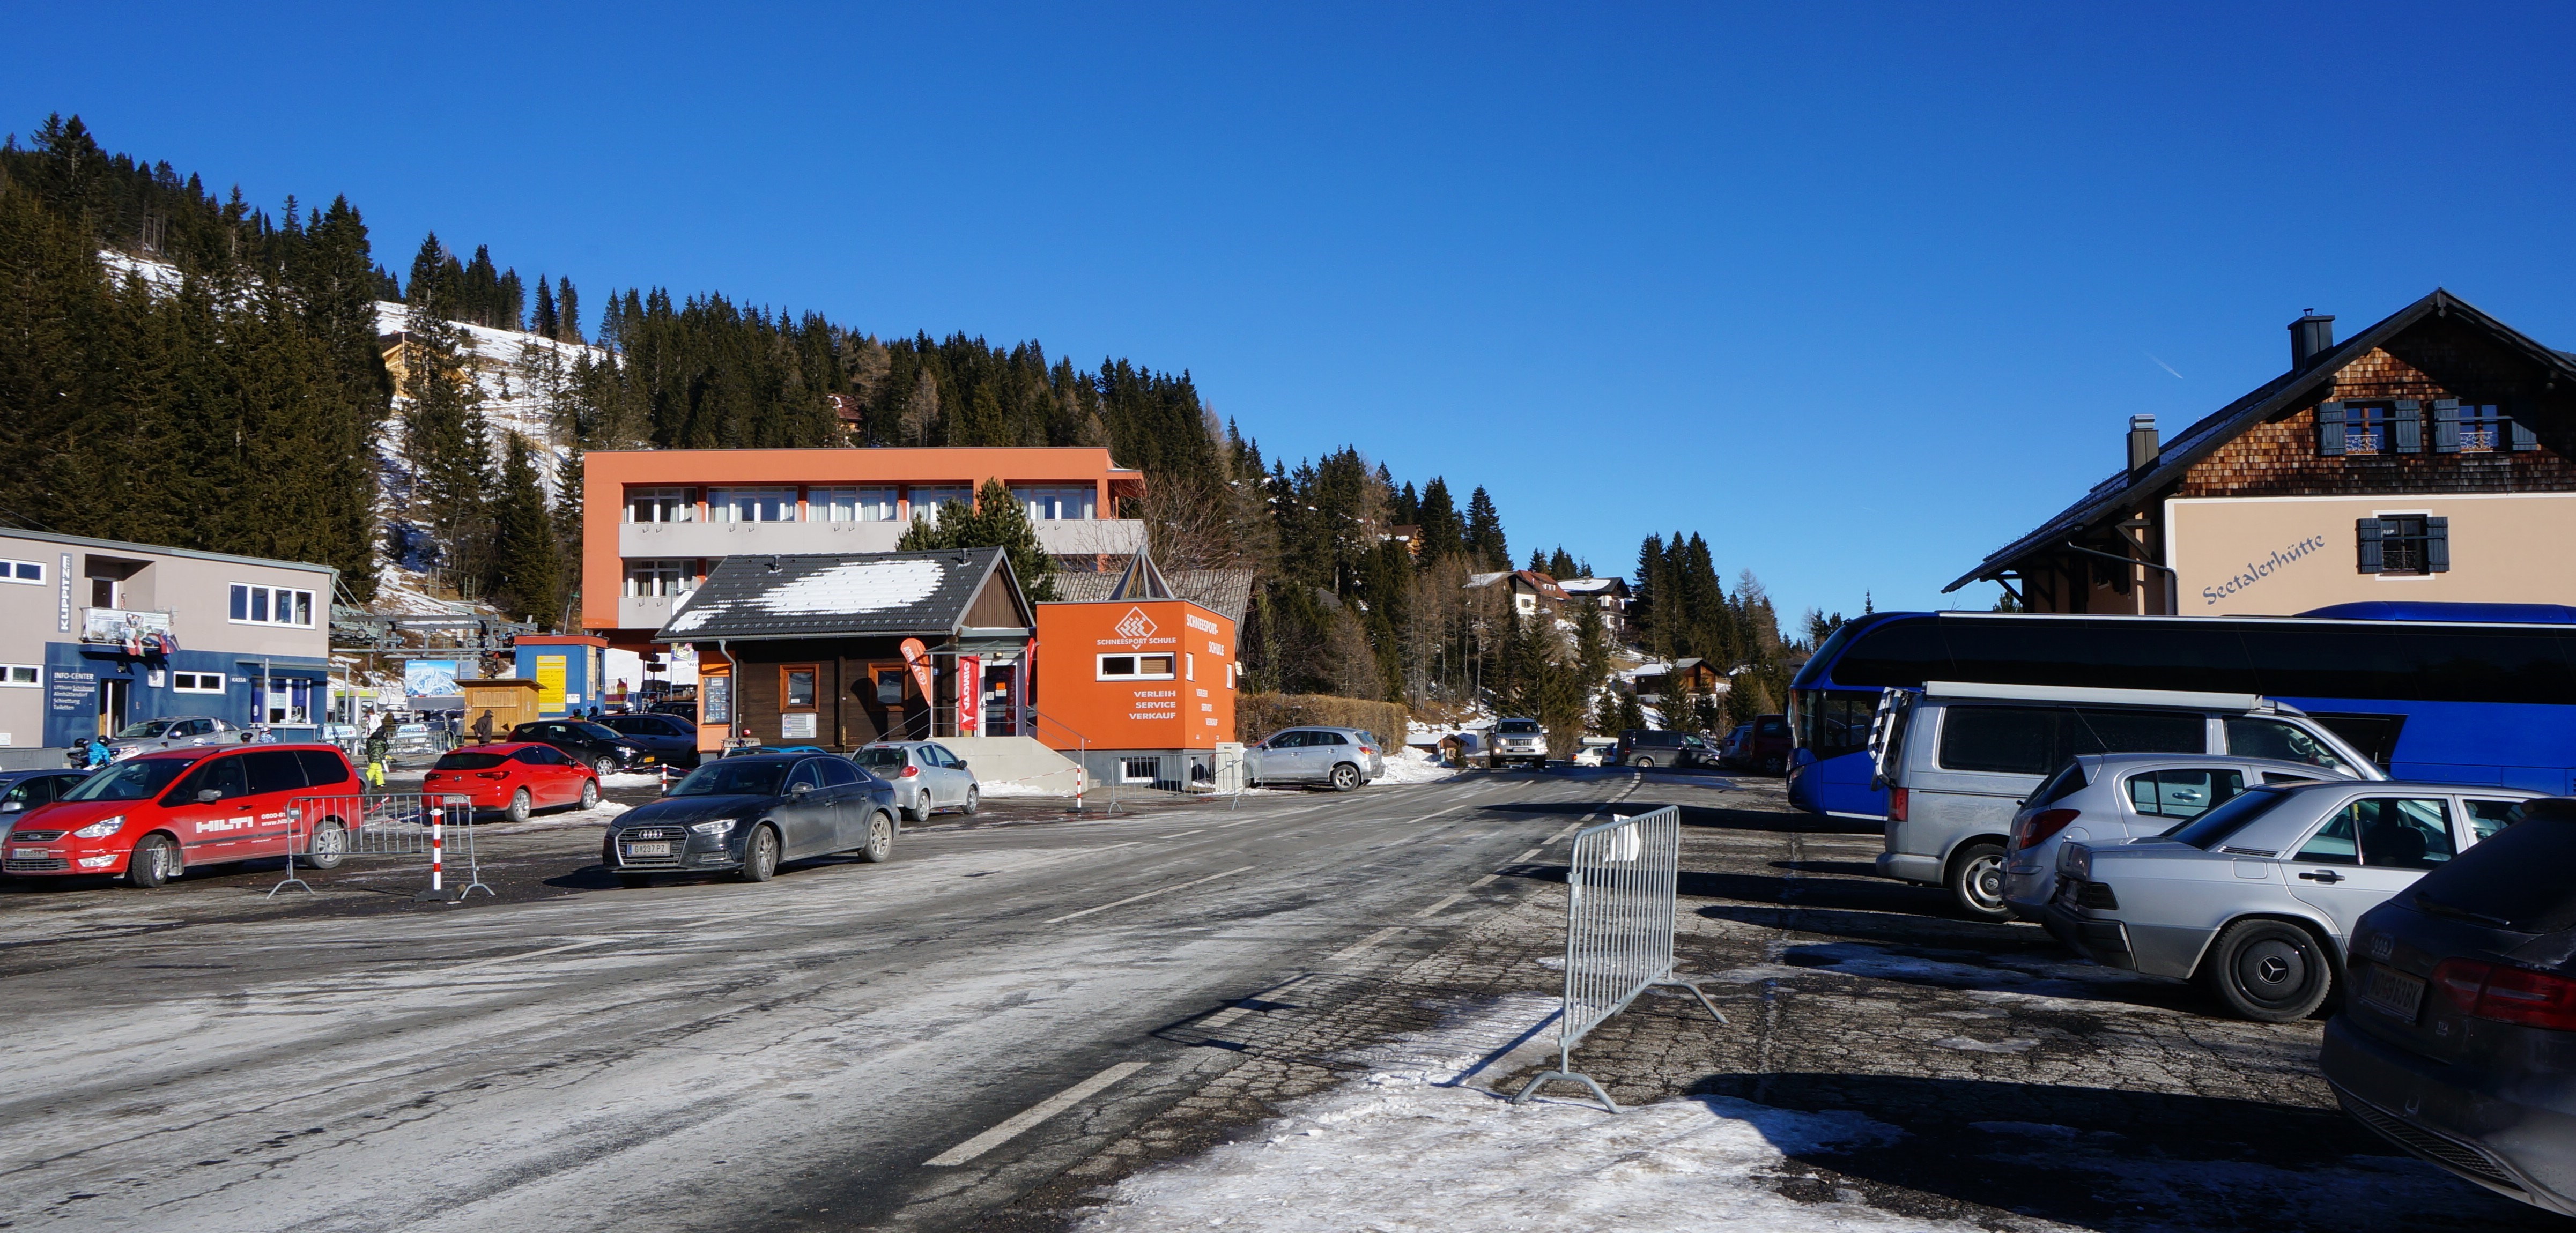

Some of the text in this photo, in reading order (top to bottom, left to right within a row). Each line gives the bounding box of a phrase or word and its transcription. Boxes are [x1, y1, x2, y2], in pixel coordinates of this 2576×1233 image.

[2203, 535, 2325, 605] Seetalerhütte
[61, 568, 70, 630] KLIPPITZ
[1187, 613, 1218, 635] SCHNEESPORT-
[1208, 641, 1224, 656] SCHULE
[54, 672, 94, 680] INFO-CENTER
[196, 816, 254, 834] HILTI
[634, 844, 665, 853] G 237 PZ
